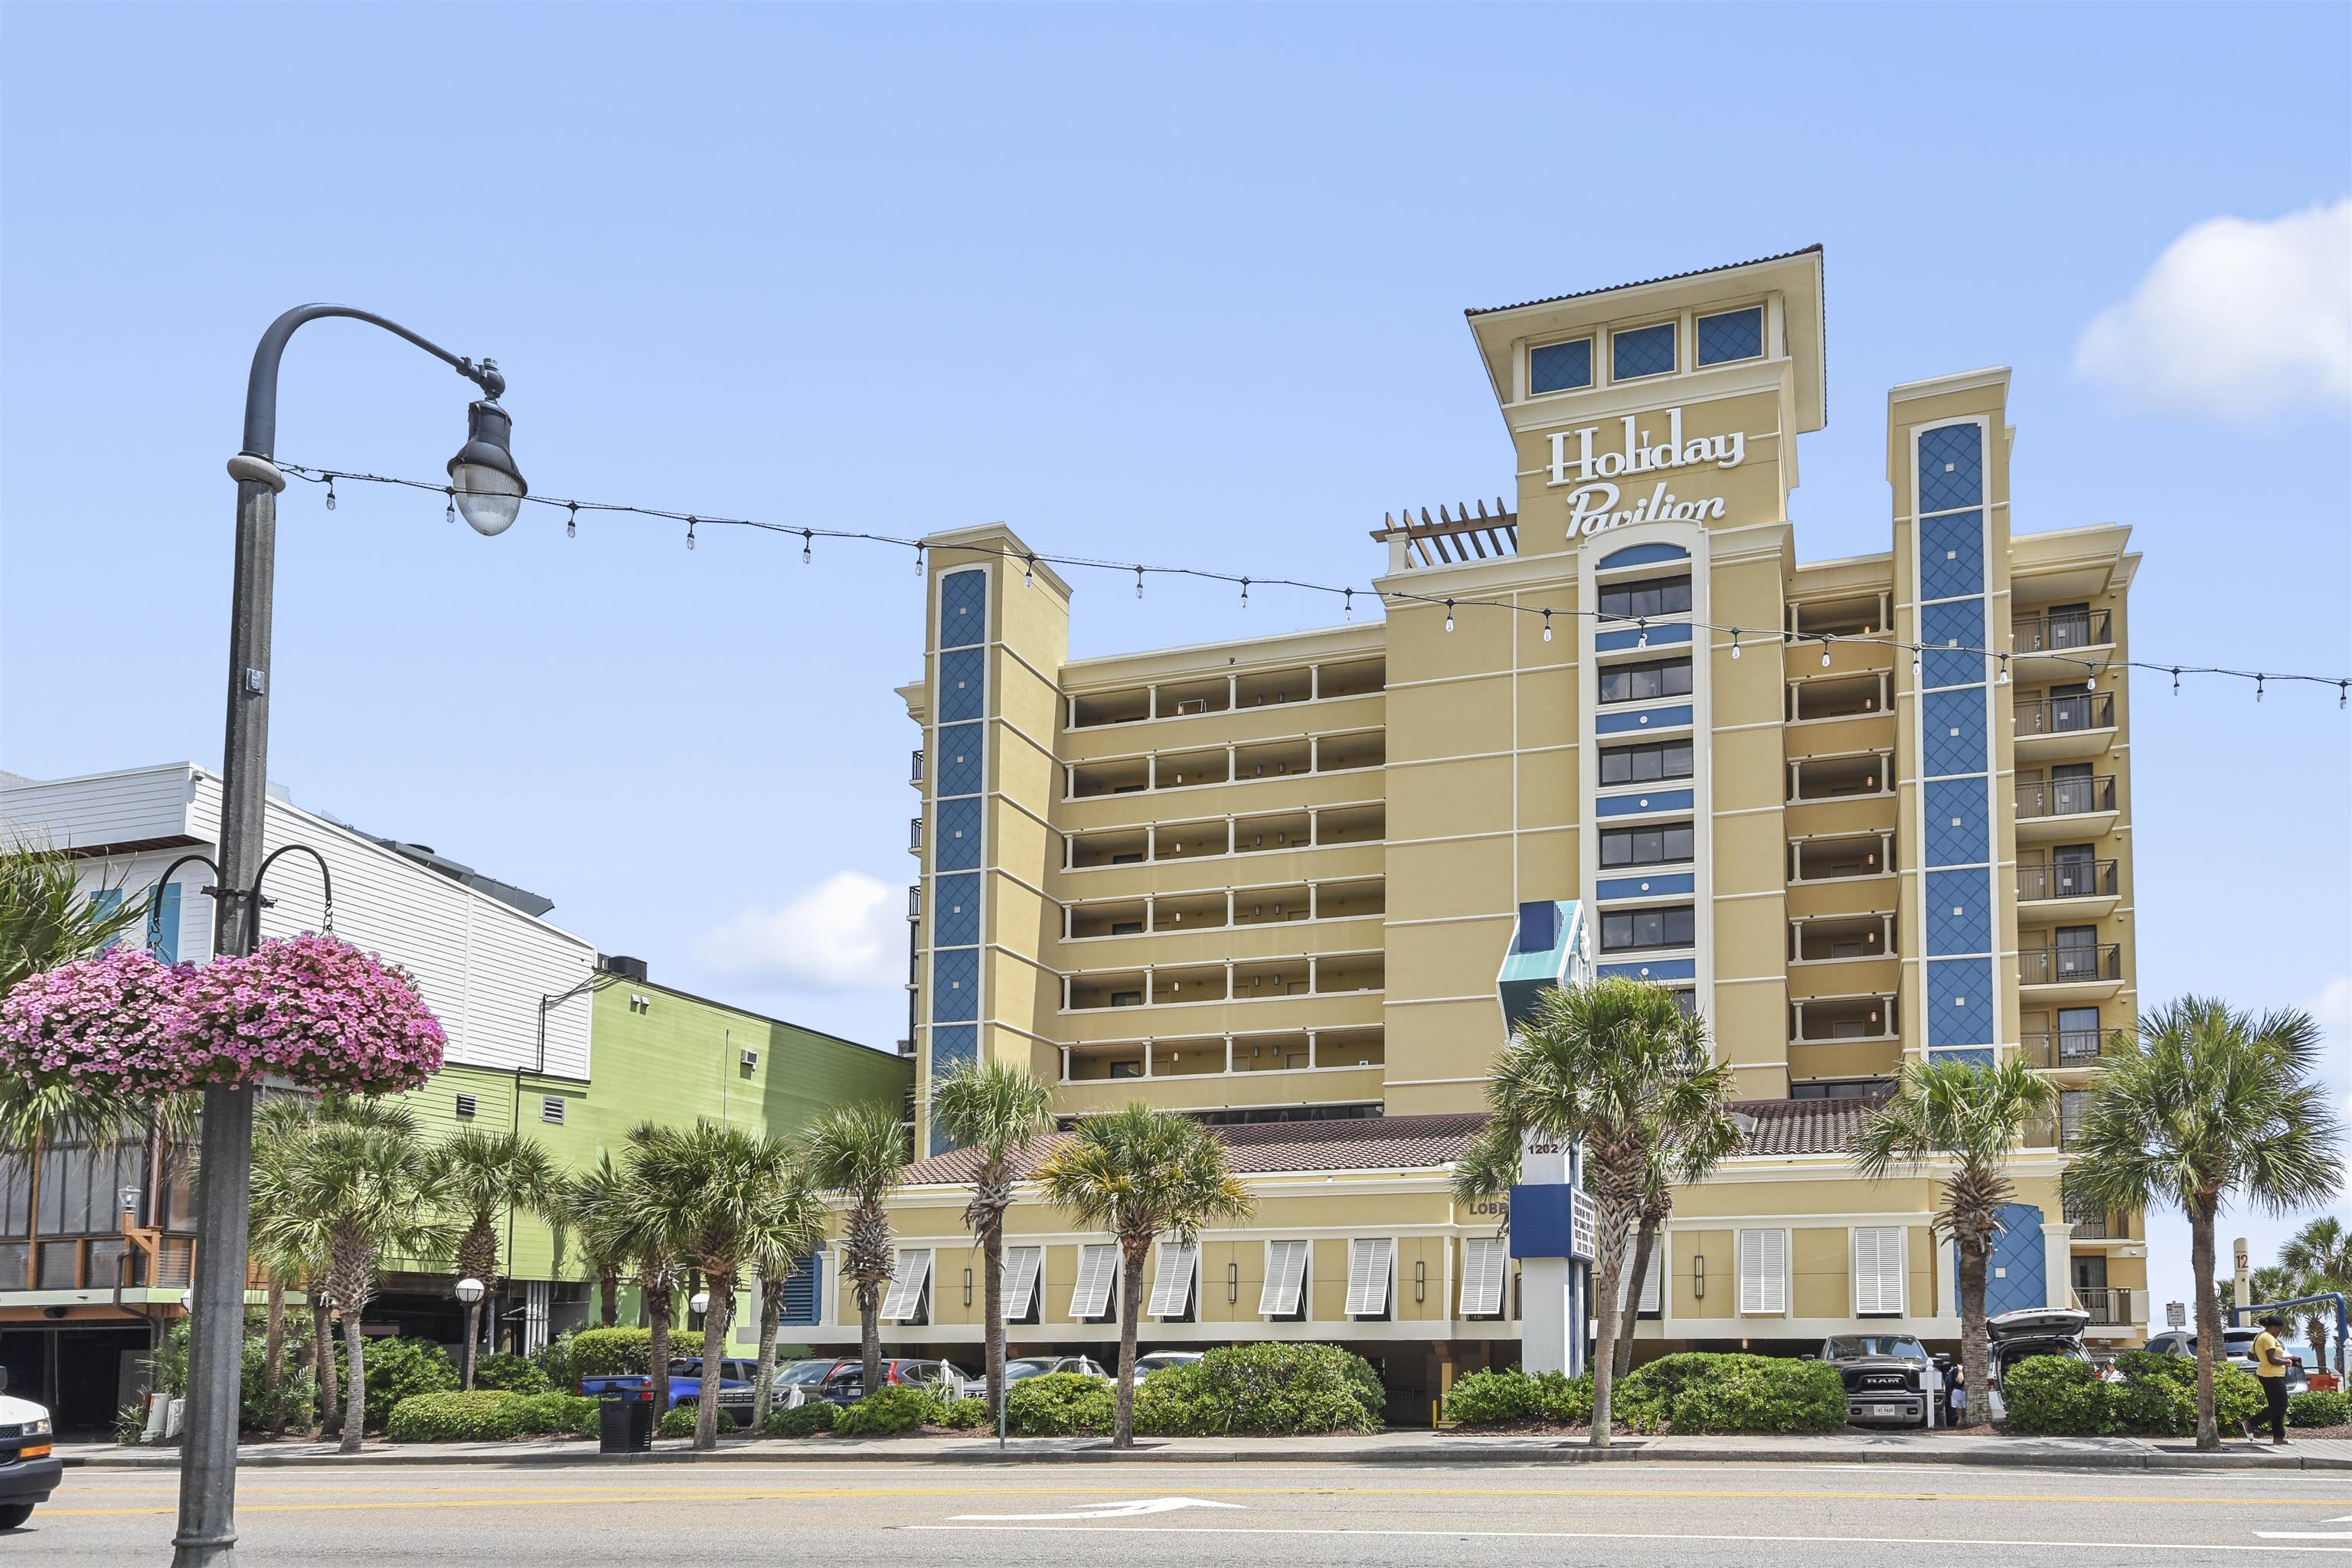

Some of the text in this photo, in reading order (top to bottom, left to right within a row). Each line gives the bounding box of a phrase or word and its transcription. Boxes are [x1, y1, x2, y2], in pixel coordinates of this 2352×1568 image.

[1546, 407, 1746, 487] Holiday
[1566, 482, 1726, 540] Pavilion
[1527, 1144, 1559, 1155] 1202
[1469, 1202, 1509, 1216] LOBB
[2236, 1254, 2249, 1269] 12
